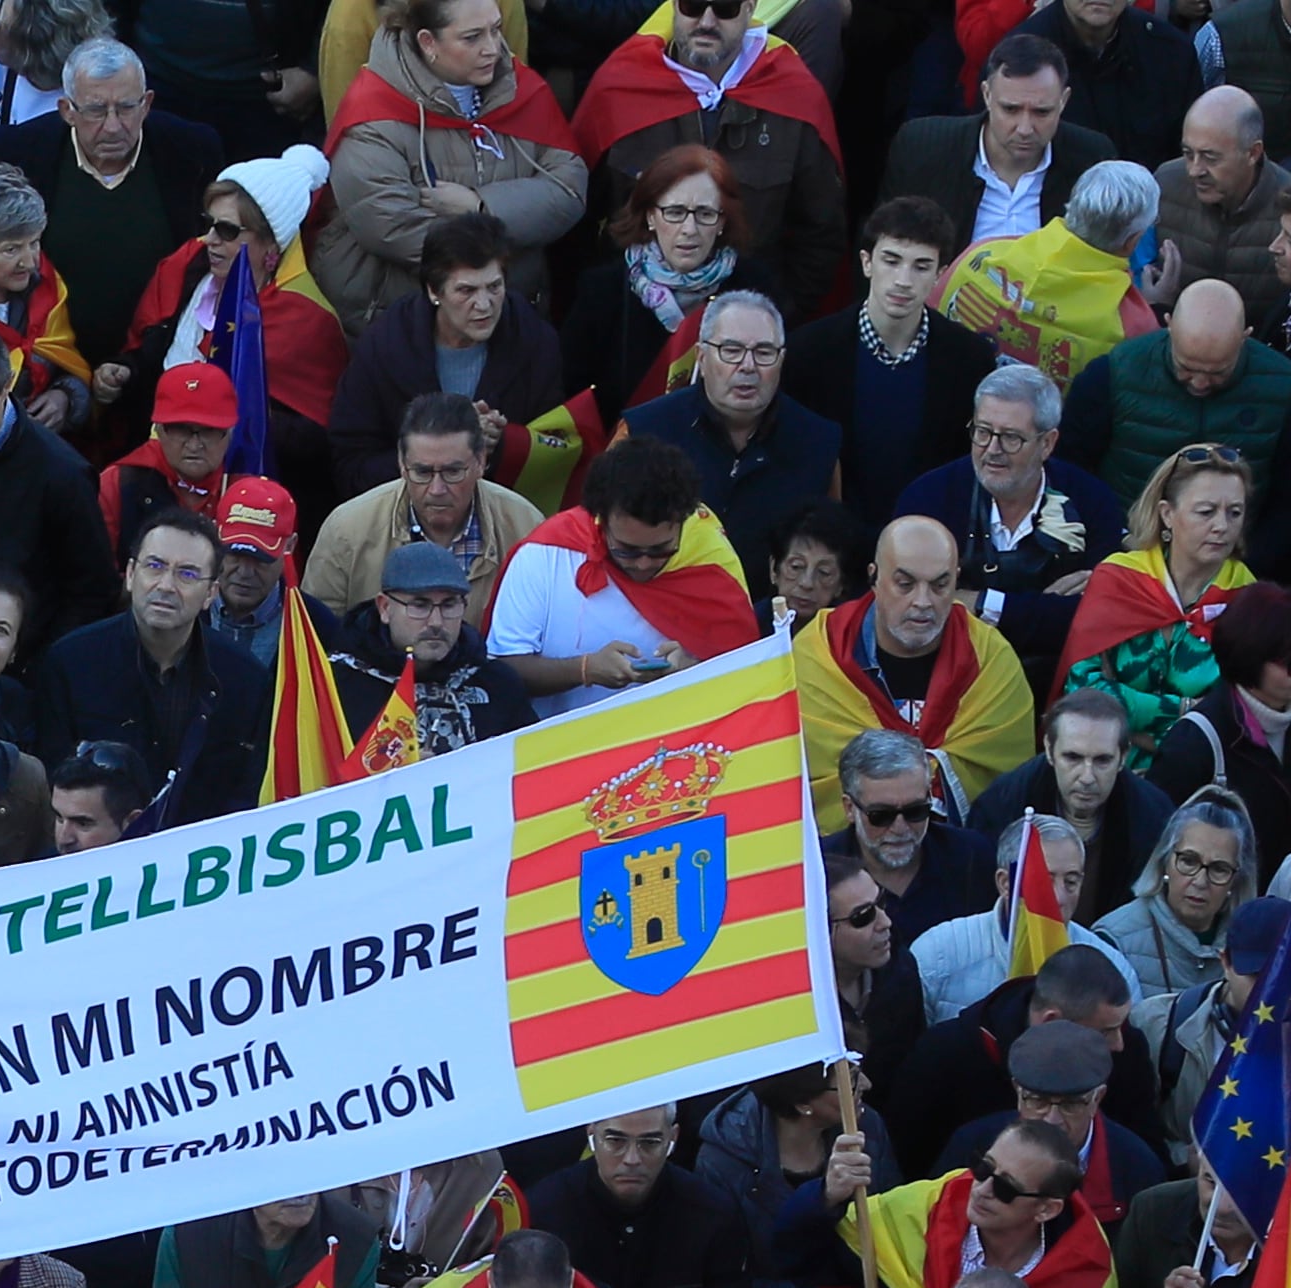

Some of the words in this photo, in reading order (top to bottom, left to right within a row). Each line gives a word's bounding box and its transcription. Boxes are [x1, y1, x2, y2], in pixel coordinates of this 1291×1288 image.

[50, 996, 132, 1076] MI
[154, 906, 480, 1046] NOMBRE
[6, 1110, 59, 1145] NI
[72, 1039, 294, 1141] AMNISTÍA
